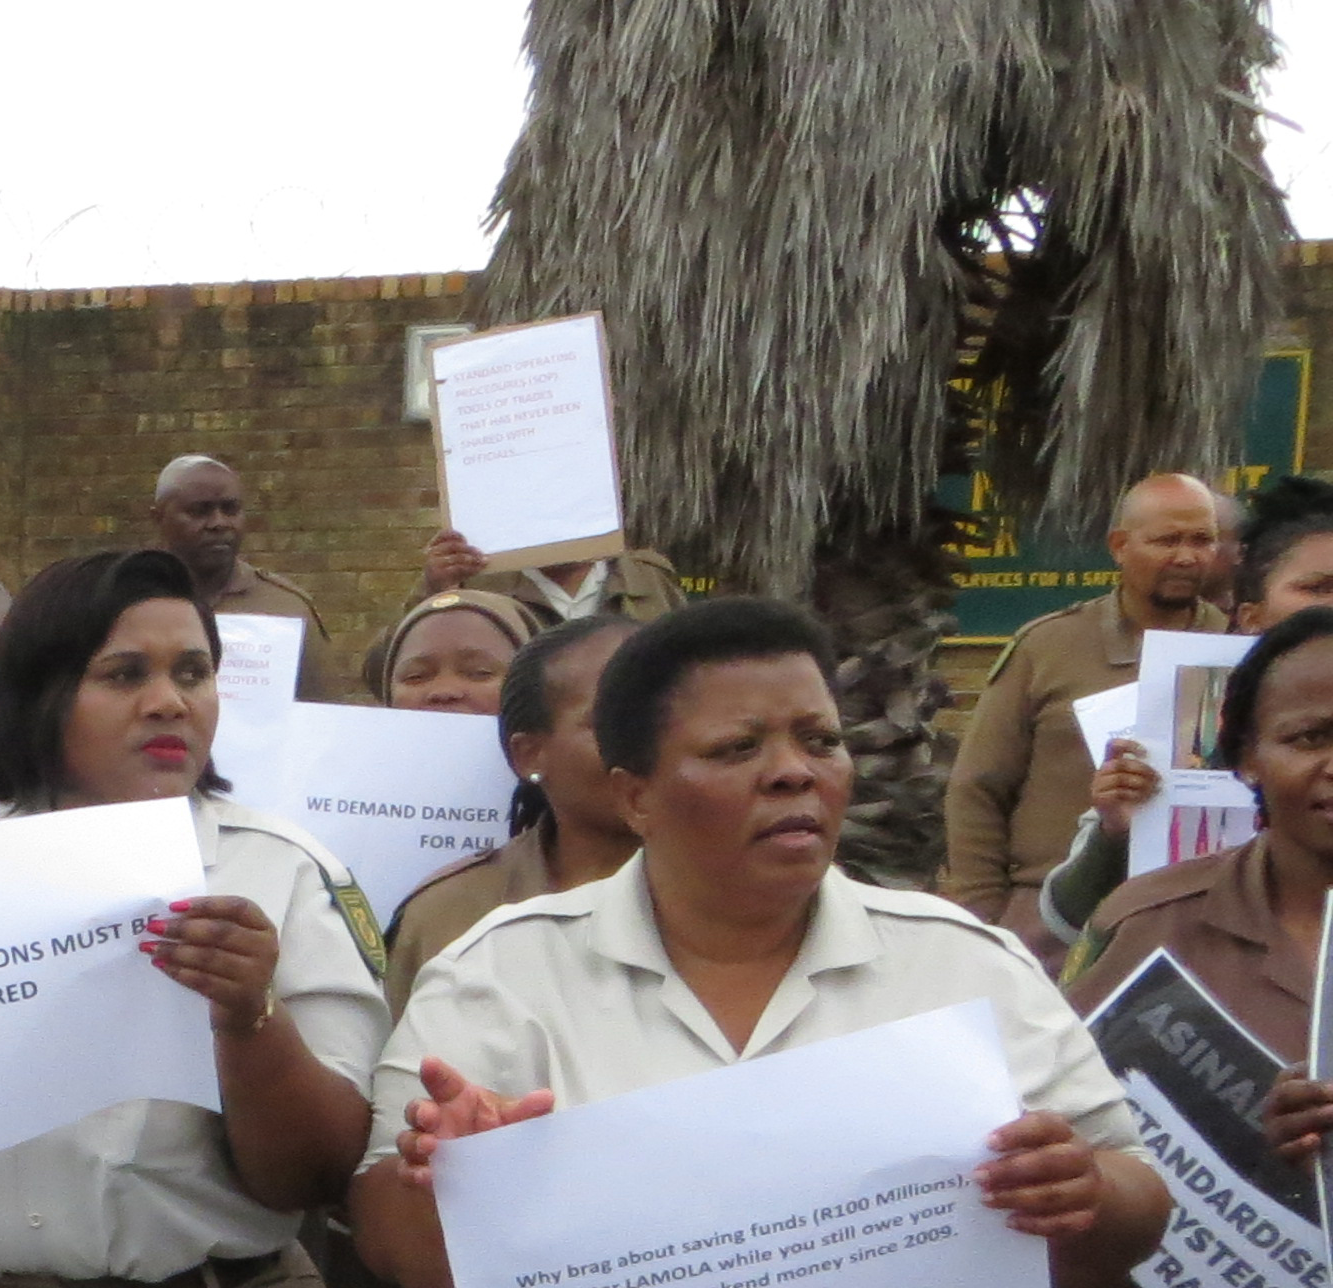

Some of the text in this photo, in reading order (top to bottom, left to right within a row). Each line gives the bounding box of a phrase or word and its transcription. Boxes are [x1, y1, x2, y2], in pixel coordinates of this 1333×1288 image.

[495, 399, 508, 408] OF
[306, 796, 331, 812] WE
[337, 799, 416, 819] DEMAND
[421, 806, 499, 823] DANGER
[420, 835, 455, 849] FOR
[51, 922, 123, 957] MUST
[516, 1174, 971, 1288] Why brag about saving funds (R100 Millions),
[718, 1247, 773, 1271] while
[779, 1238, 815, 1260] you
[821, 1225, 856, 1246] still
[862, 1213, 903, 1235] owe
[909, 1202, 956, 1227] your
[776, 1255, 844, 1283] money
[849, 1242, 898, 1264] since
[903, 1224, 959, 1249] 2009.
